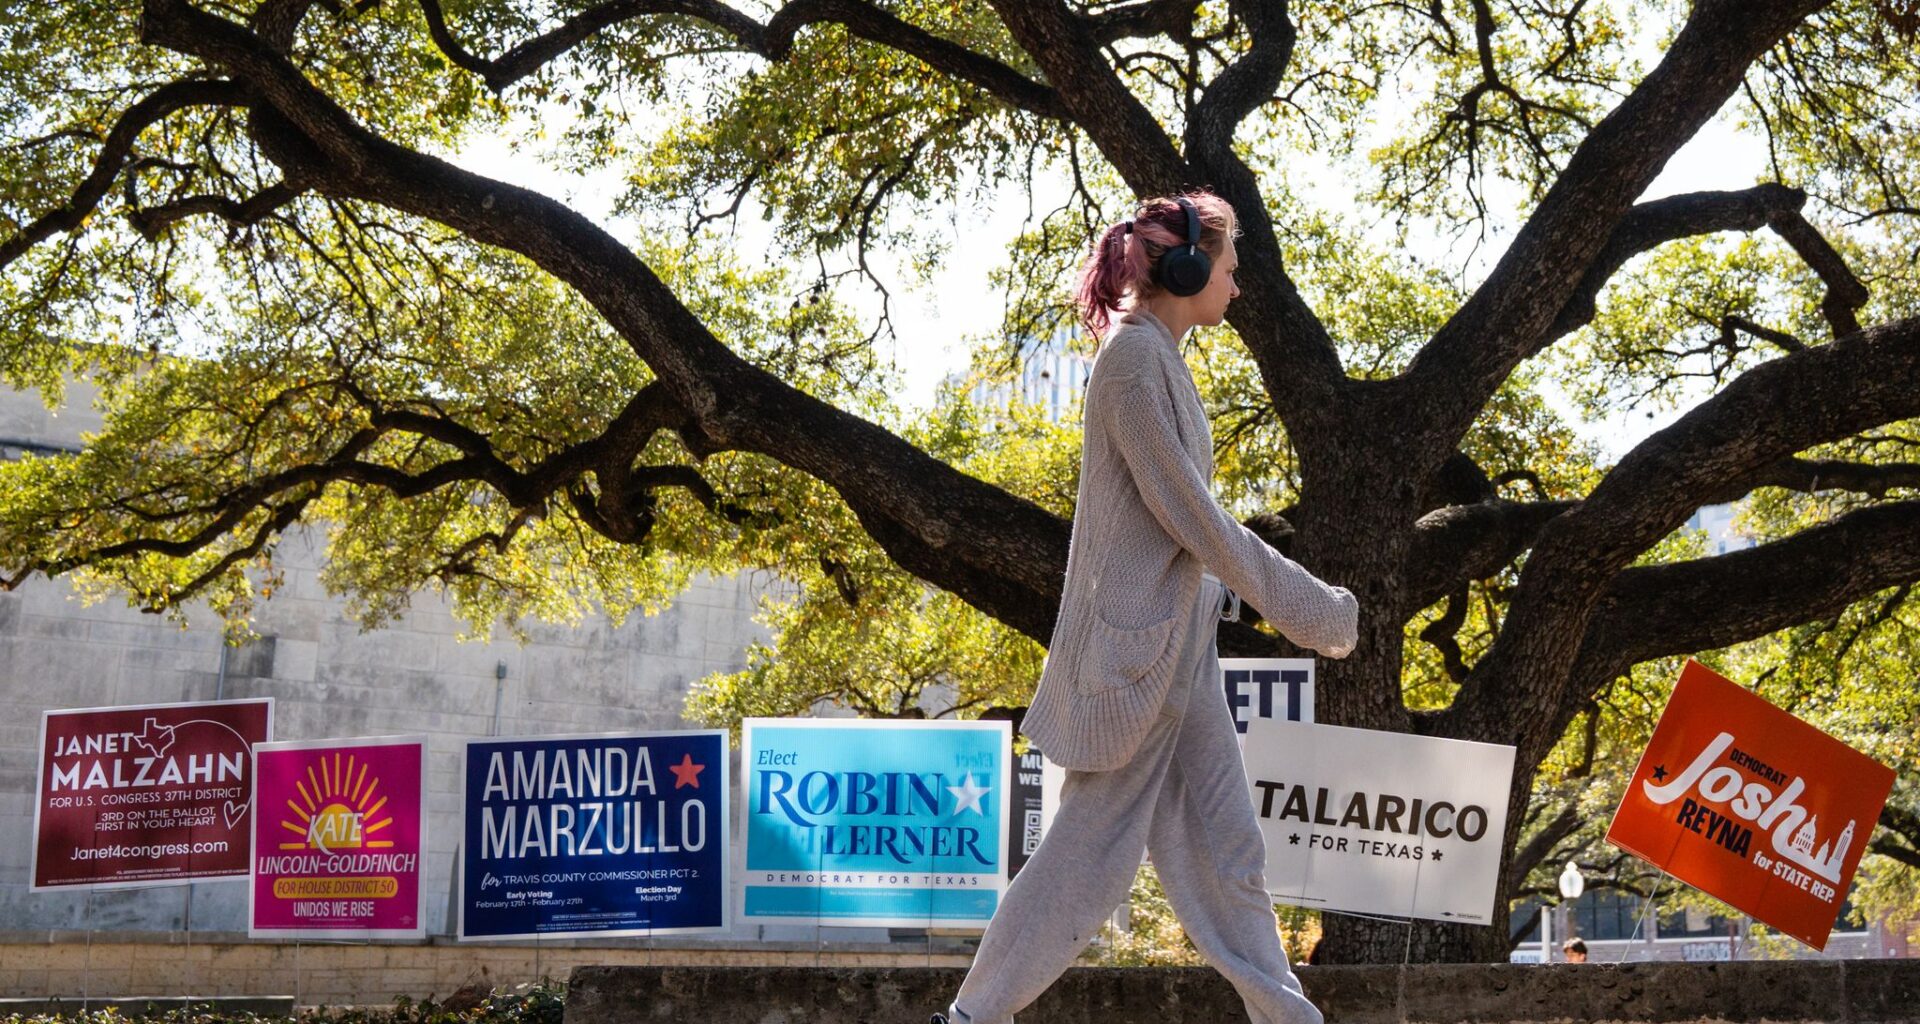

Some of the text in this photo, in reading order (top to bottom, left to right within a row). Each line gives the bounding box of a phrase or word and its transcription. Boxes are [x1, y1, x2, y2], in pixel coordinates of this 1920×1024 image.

[54, 732, 134, 757] JANET
[757, 749, 798, 765] Elect
[1729, 748, 1788, 787] DEMOCRAT
[51, 752, 243, 791] MALZAHN
[483, 746, 656, 801] AMANDA
[50, 787, 242, 808] FOR U.S. CONGRESS 37TH DISTRICT
[756, 769, 944, 828] ROBIN
[1643, 732, 1815, 862] Josh
[101, 811, 124, 821] 3RD
[127, 811, 145, 820] ON
[149, 809, 169, 819] THE
[1255, 780, 1488, 842] TALARICO
[95, 816, 216, 831] FIRST IN YOUR HEART
[306, 812, 364, 855] KATE
[481, 799, 706, 860] MARZULLO
[1675, 798, 1753, 858] REYNA
[70, 840, 228, 861] Janet4congress.com
[824, 825, 996, 865] LERNER
[1309, 834, 1424, 861] FOR TEXAS
[258, 853, 416, 875] LINCOLN-GOLDFINCH
[277, 879, 395, 894] FOR HOUSE DISTRICT 50
[481, 872, 502, 890] for
[503, 874, 540, 884] TRAVIS
[542, 872, 587, 883] COUNTY
[588, 869, 668, 881] COMMISSIONER
[670, 868, 690, 879] PCT
[767, 874, 978, 886] DEMOCRAT FOR TEXAS
[1753, 851, 1835, 903] for STATE REP.
[506, 890, 553, 900] Early Voting
[635, 885, 682, 894] Election Day
[640, 893, 677, 902] March 3rd
[293, 901, 375, 917] UNIDOS WE RISE
[476, 900, 509, 909] February
[510, 899, 526, 907] 17th
[532, 898, 565, 907] February
[566, 897, 583, 905] 27th
